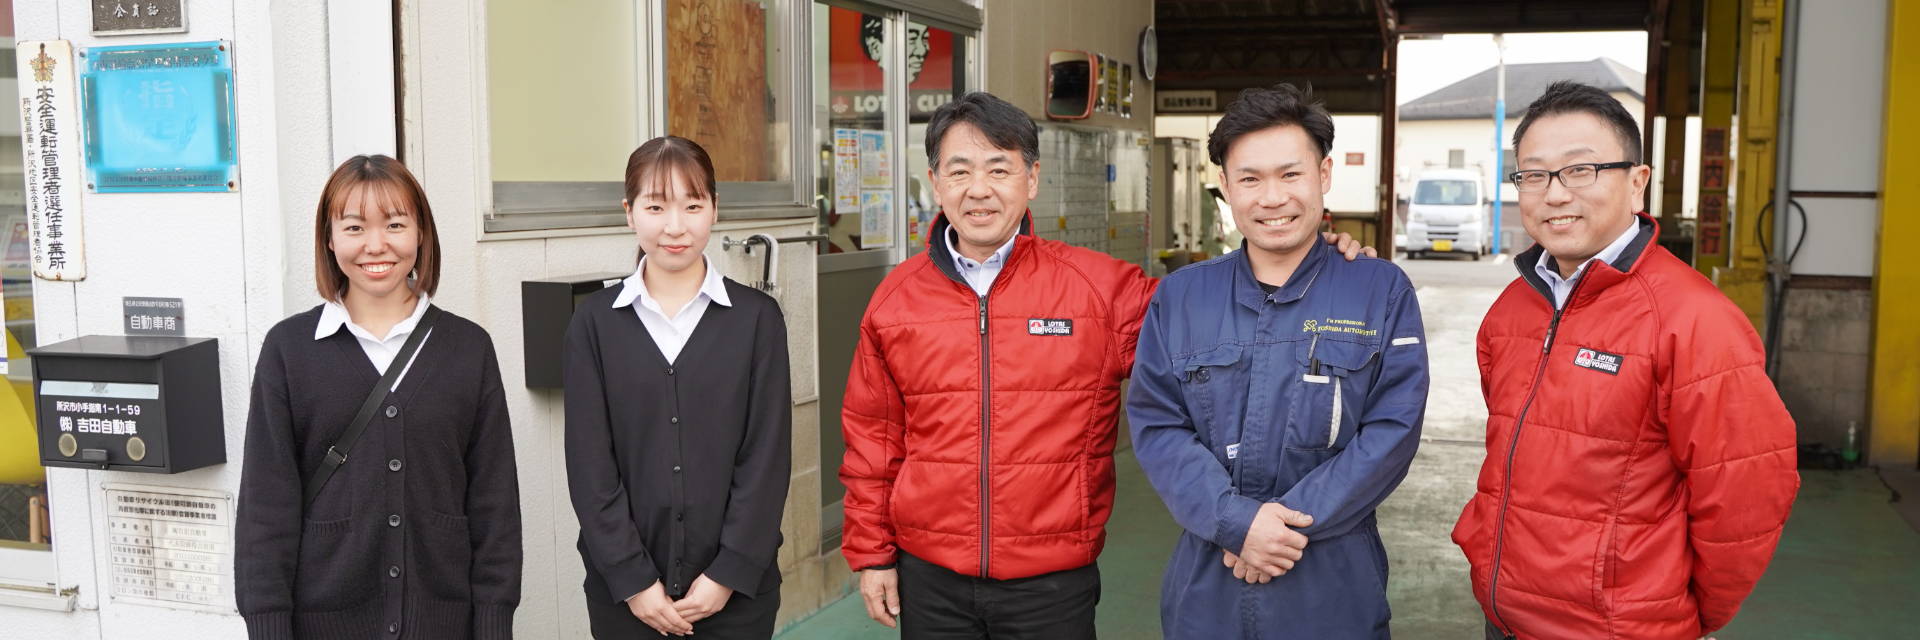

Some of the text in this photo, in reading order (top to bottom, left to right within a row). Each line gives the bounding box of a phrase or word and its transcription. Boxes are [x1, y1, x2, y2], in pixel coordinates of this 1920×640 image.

[36, 86, 66, 270] 安全運転管理者選任事業所
[131, 315, 175, 330] 自動車商
[1591, 361, 1617, 372] YOSHIDA
[77, 417, 138, 435] 吉田自動車
